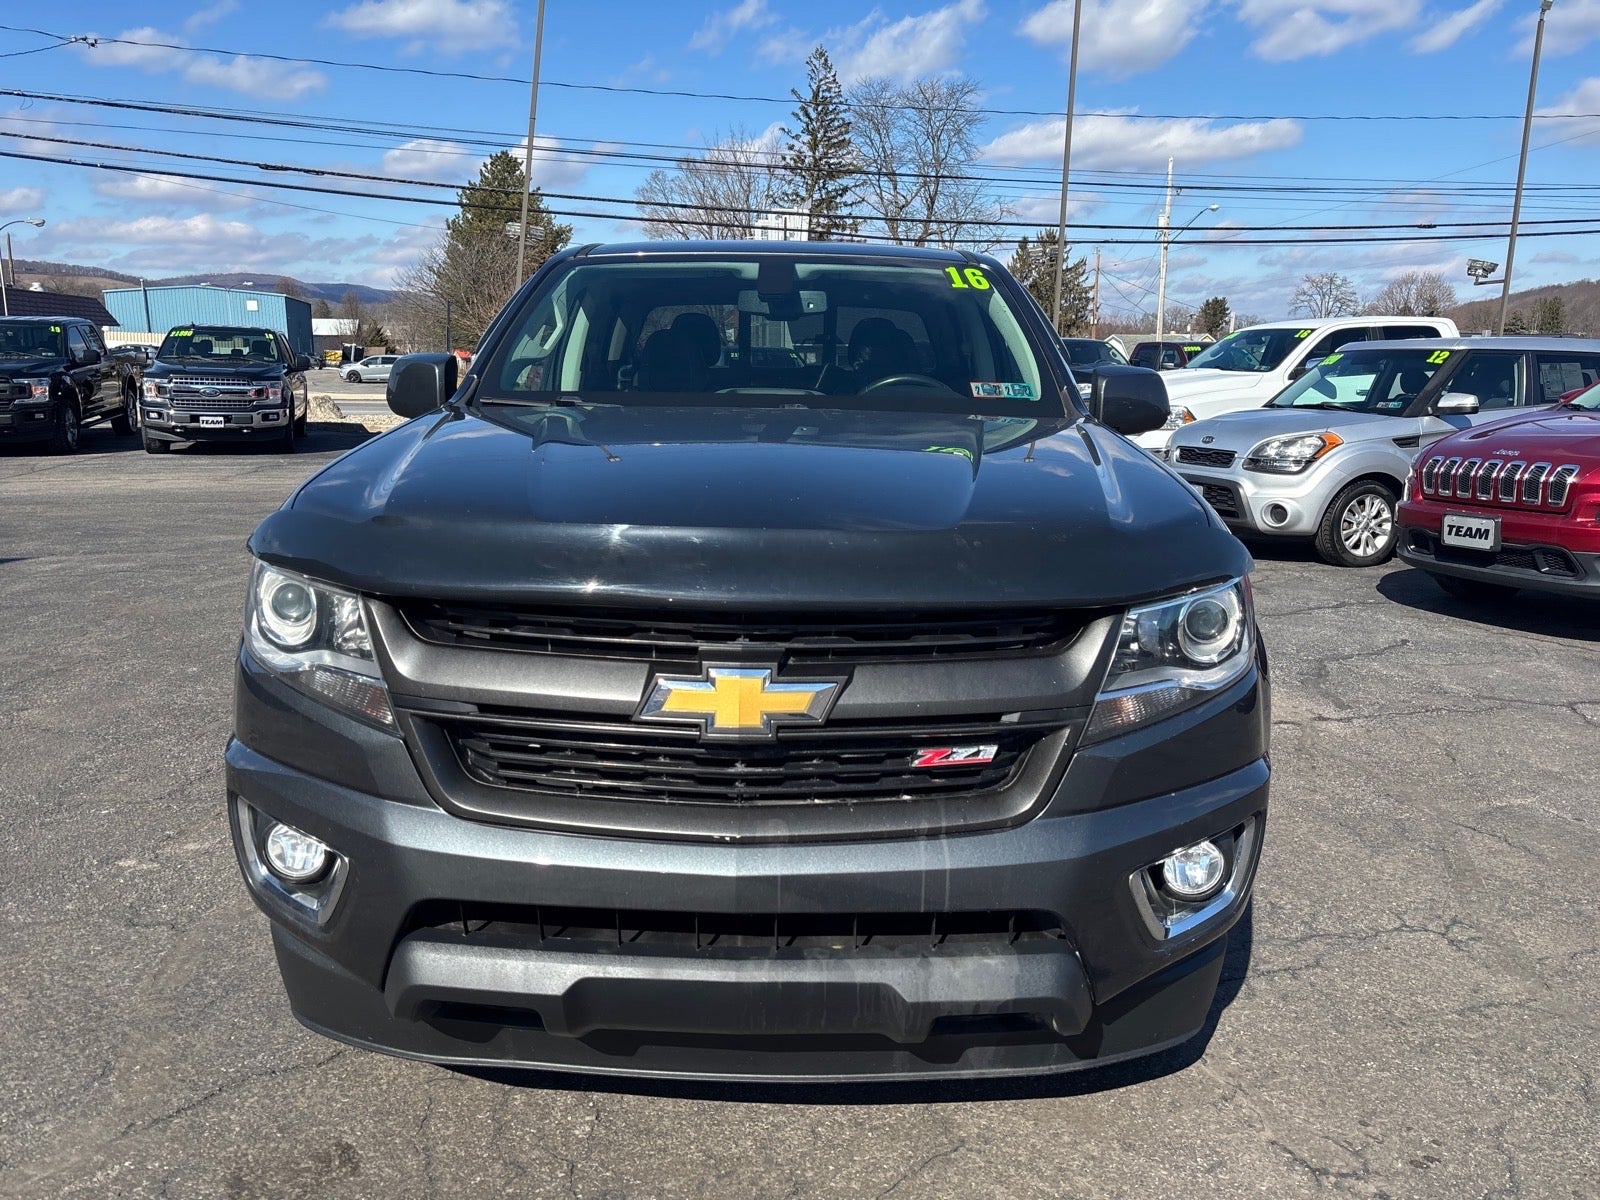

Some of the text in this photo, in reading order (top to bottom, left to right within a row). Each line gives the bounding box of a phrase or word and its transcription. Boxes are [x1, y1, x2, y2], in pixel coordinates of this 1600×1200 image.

[944, 266, 990, 290] 16
[1294, 329, 1312, 339] 16
[1425, 350, 1450, 365] 12
[1446, 524, 1491, 541] TEAM
[911, 744, 999, 767] Z71
